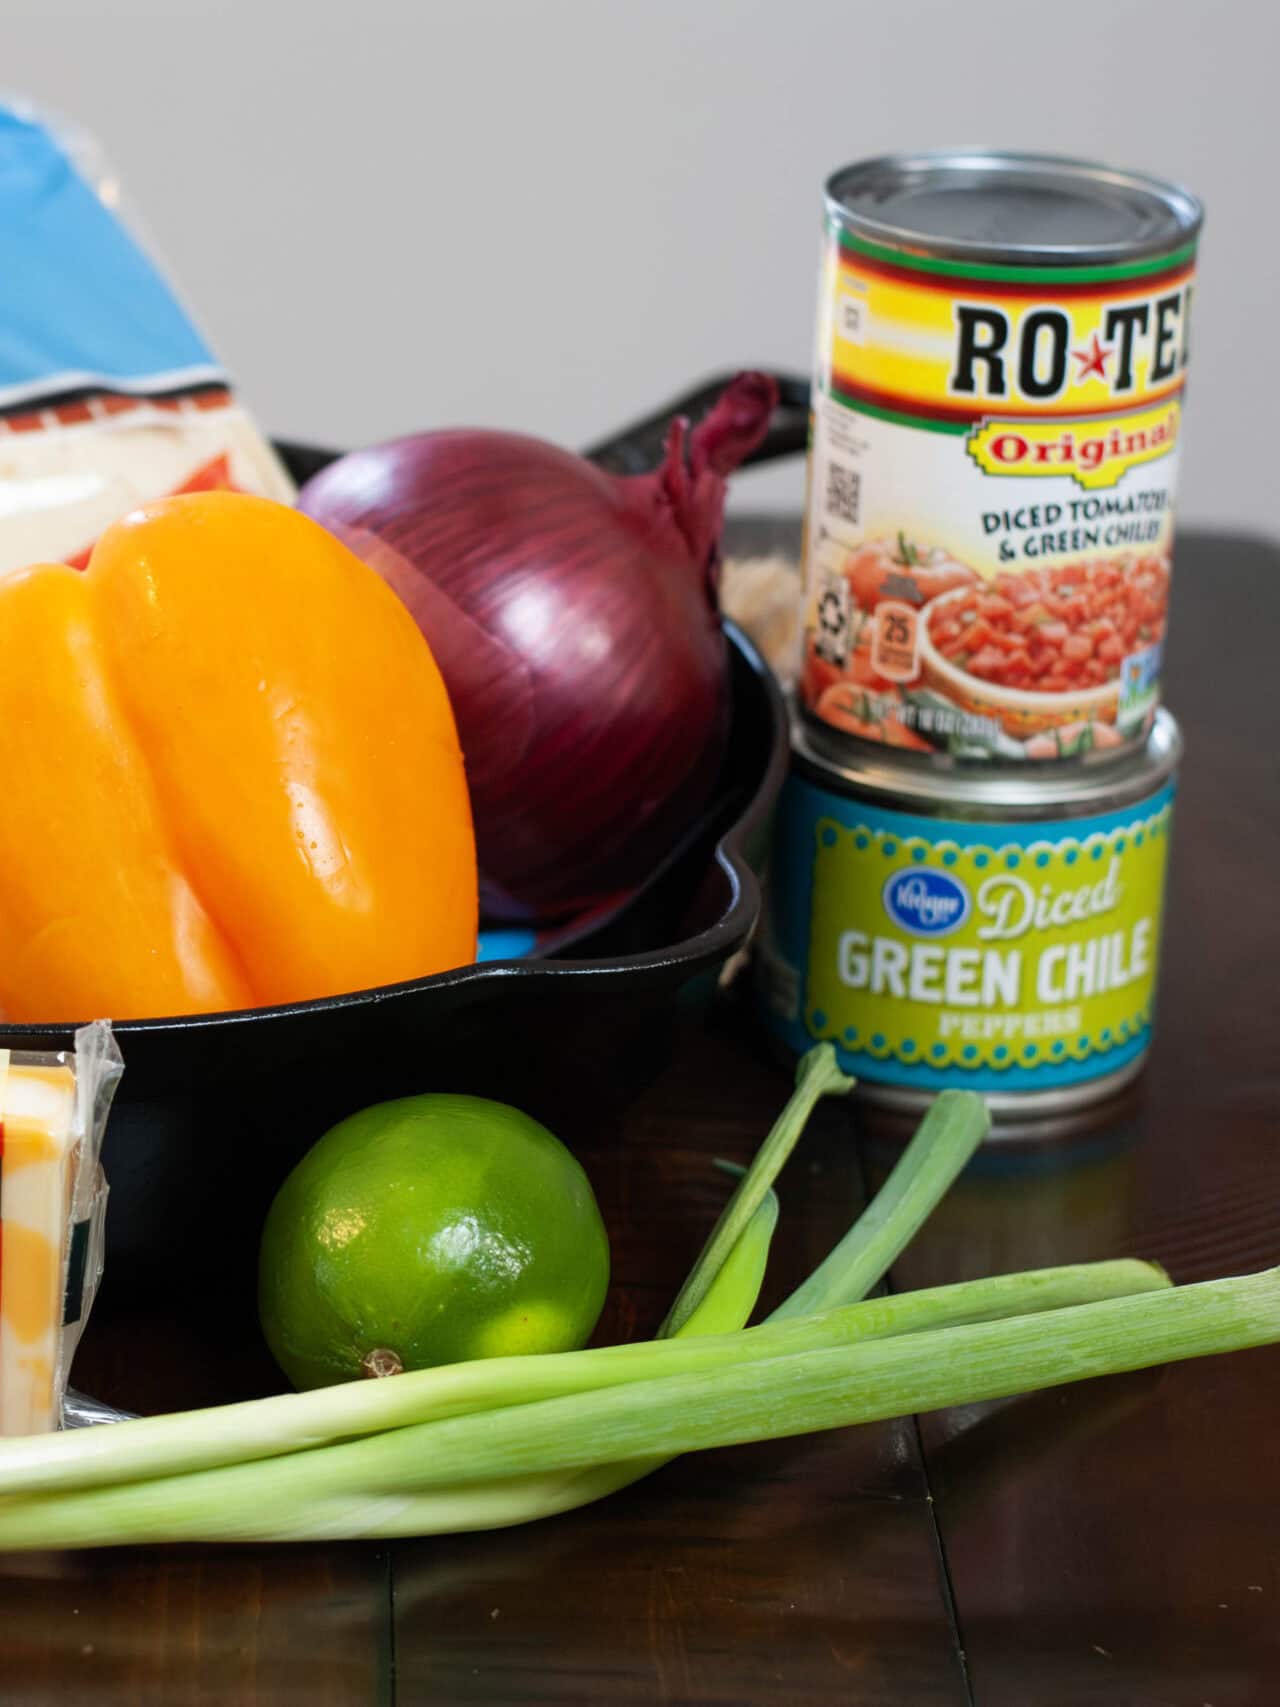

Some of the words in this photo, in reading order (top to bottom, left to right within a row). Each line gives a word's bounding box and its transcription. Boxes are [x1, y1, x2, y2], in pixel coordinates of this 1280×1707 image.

[989, 414, 1175, 471] Original
[981, 501, 1063, 534] DICED
[998, 540, 1016, 563] &
[1023, 529, 1101, 560] GREEN
[977, 854, 1120, 941] Diced
[837, 929, 1021, 1006] GREEN
[1036, 917, 1151, 1004] CHILE
[939, 1006, 1081, 1040] PEPPERS
